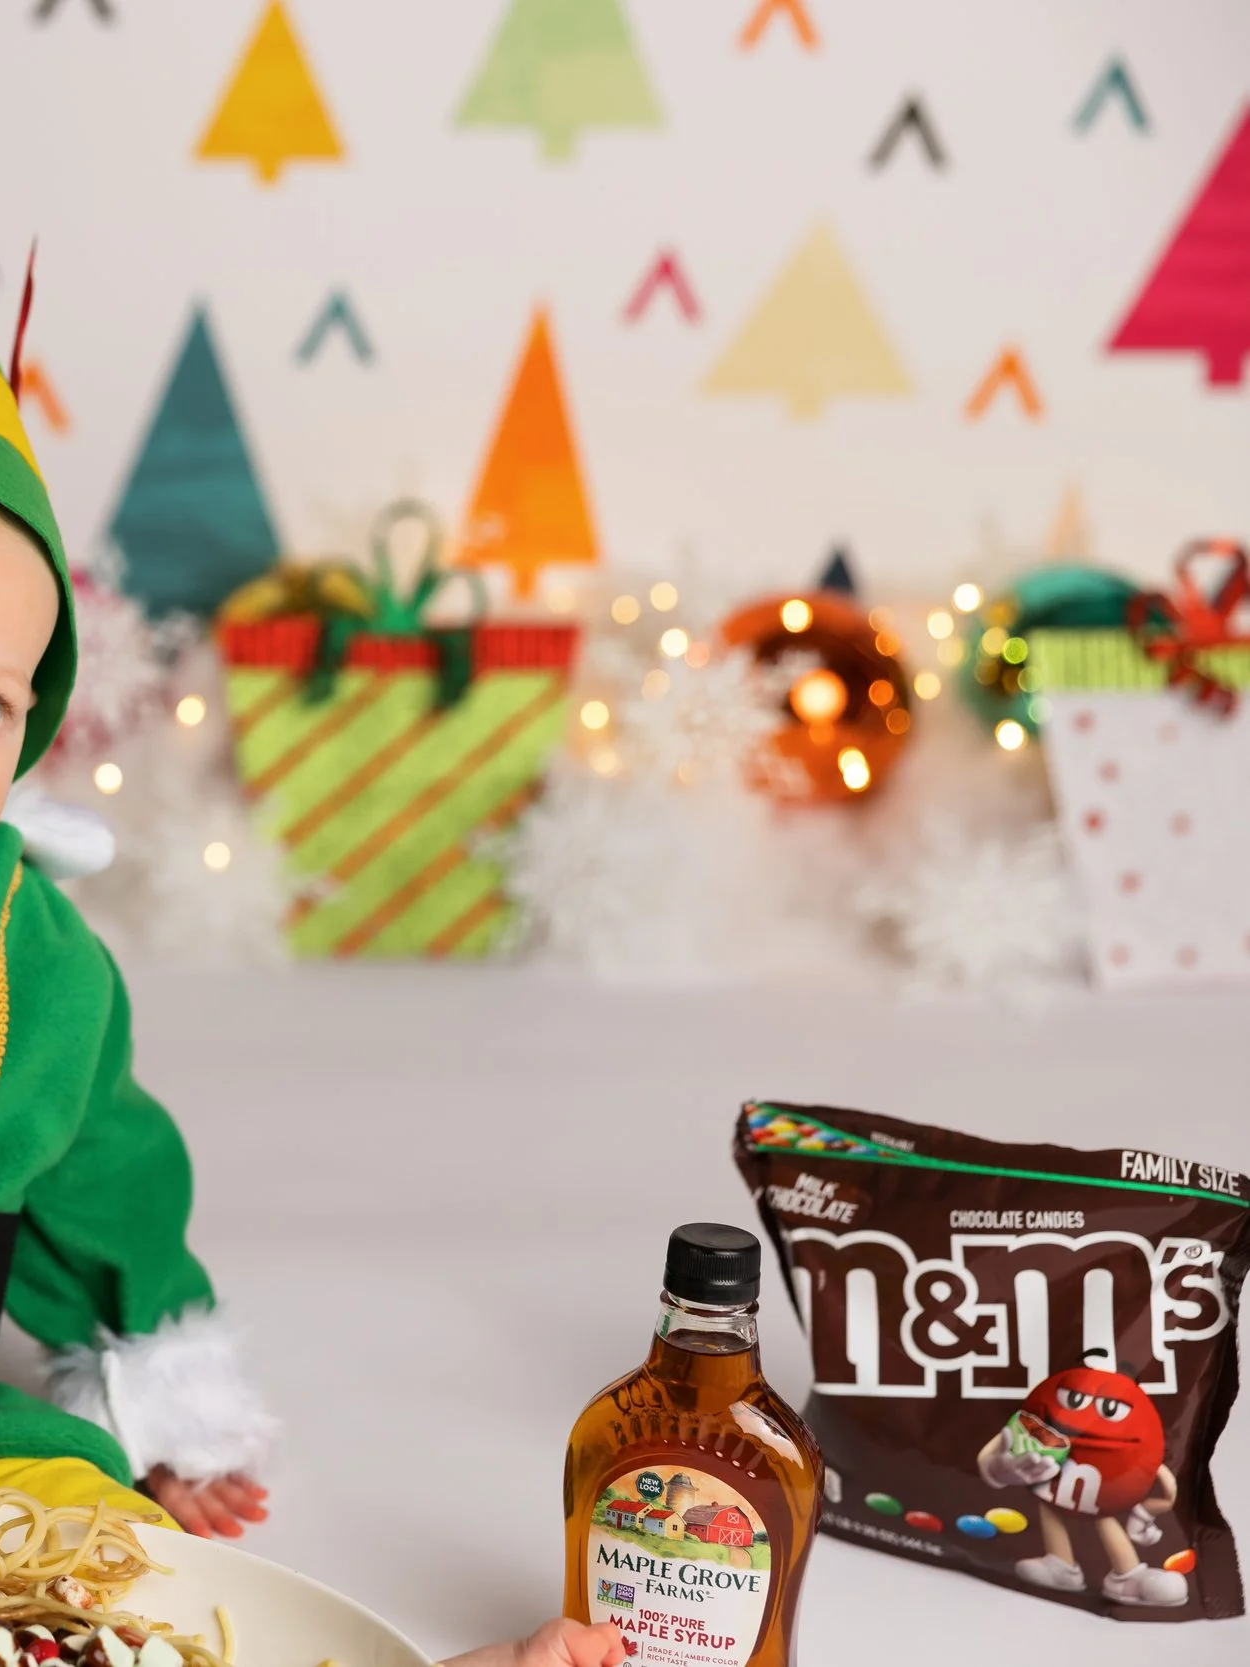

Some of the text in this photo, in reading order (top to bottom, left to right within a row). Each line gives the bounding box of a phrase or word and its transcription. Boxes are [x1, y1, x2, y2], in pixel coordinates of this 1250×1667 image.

[1120, 1150, 1242, 1197] FAMILY SIZE
[794, 1172, 840, 1199] MILK
[950, 1209, 1085, 1230] CHOCOLATE CANDIES
[639, 1483, 661, 1495] LOOK
[642, 1477, 660, 1488] NEW
[597, 1543, 761, 1593] MAPLE GROVE
[617, 1584, 634, 1593] NON
[617, 1589, 634, 1598] GMO
[645, 1578, 705, 1603] FARMS
[597, 1594, 634, 1608] VERIFIED
[638, 1608, 668, 1625] 100%
[670, 1615, 706, 1631] PURE
[609, 1613, 736, 1650] MAPLE SYRUP
[647, 1645, 739, 1667] GRADE A AMBER COLOR
[647, 1653, 688, 1667] RICH TASTE
